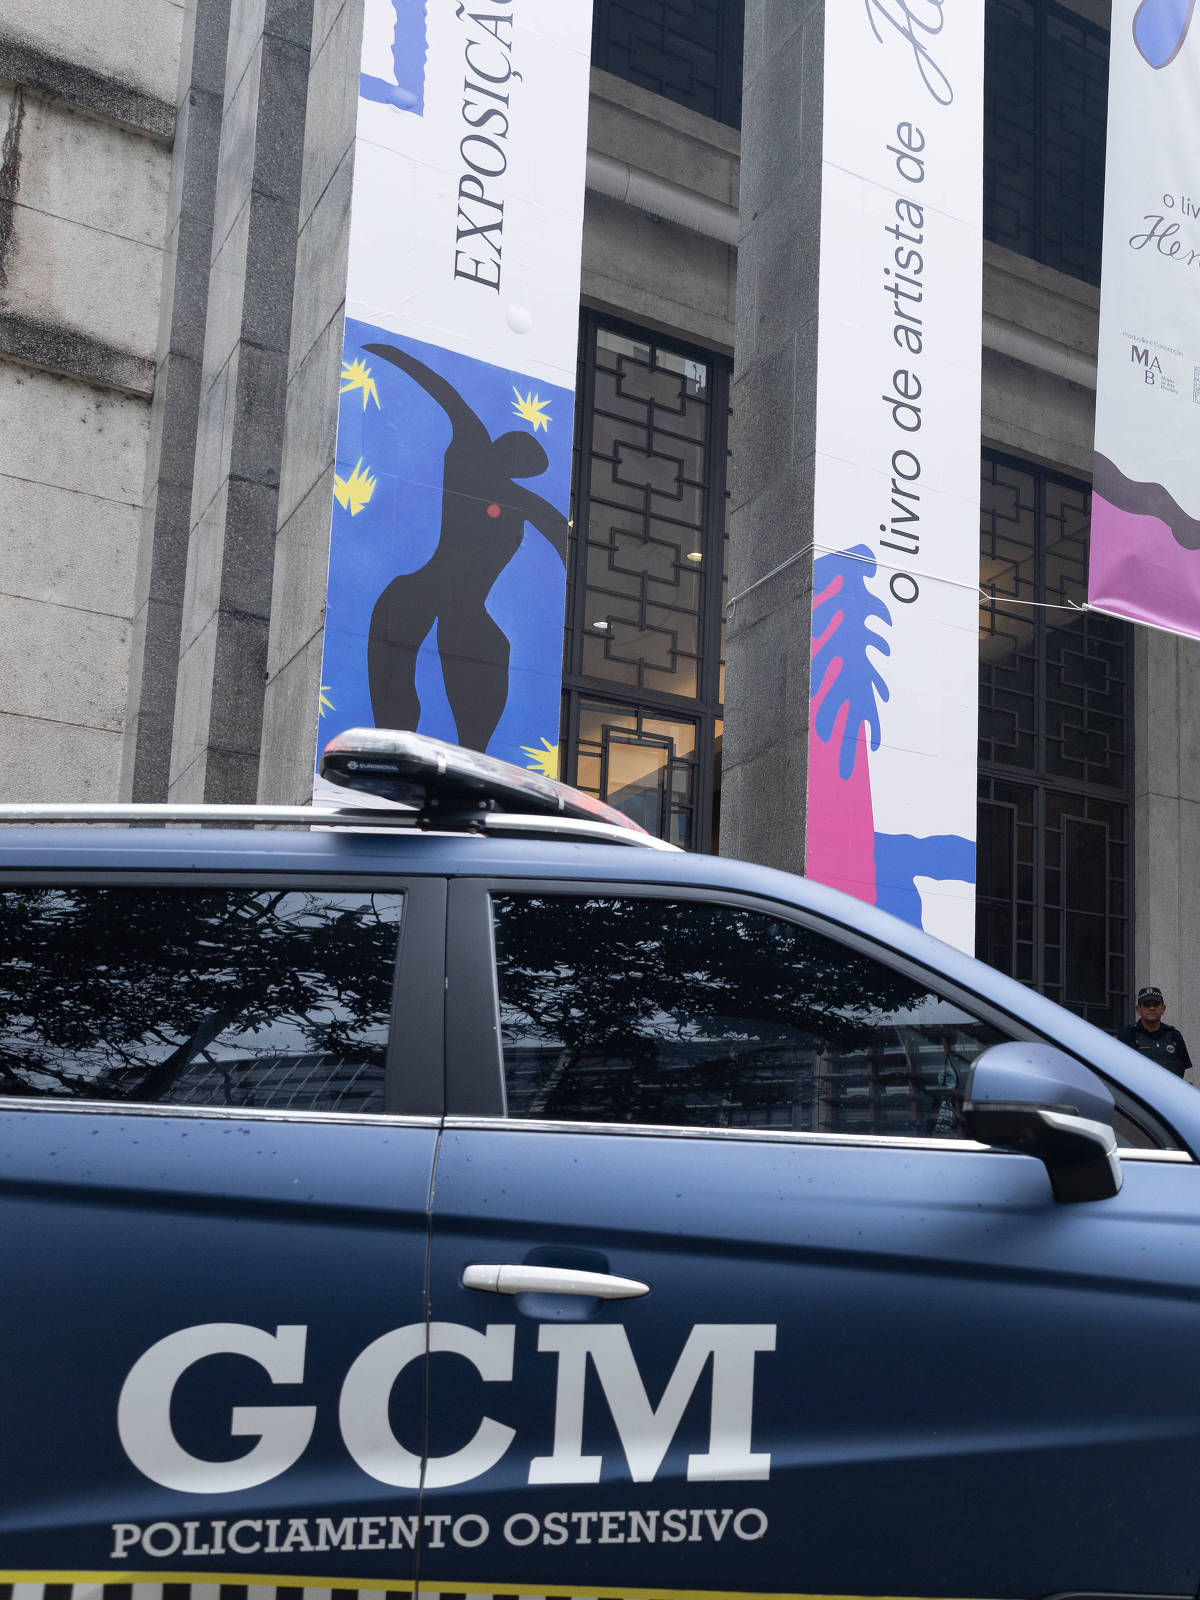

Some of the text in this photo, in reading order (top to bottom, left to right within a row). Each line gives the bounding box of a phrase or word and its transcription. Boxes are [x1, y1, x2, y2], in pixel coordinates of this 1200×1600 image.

[454, 0, 523, 295] EXPOSIÇÃ
[886, 121, 926, 184] de
[1162, 193, 1175, 208] o
[883, 198, 924, 354] artista
[882, 369, 922, 433] de
[879, 449, 922, 555] livro
[889, 572, 920, 604] o
[116, 1321, 778, 1494] GCM
[110, 1507, 769, 1559] POLICIAMENTO OSTENSIVO
